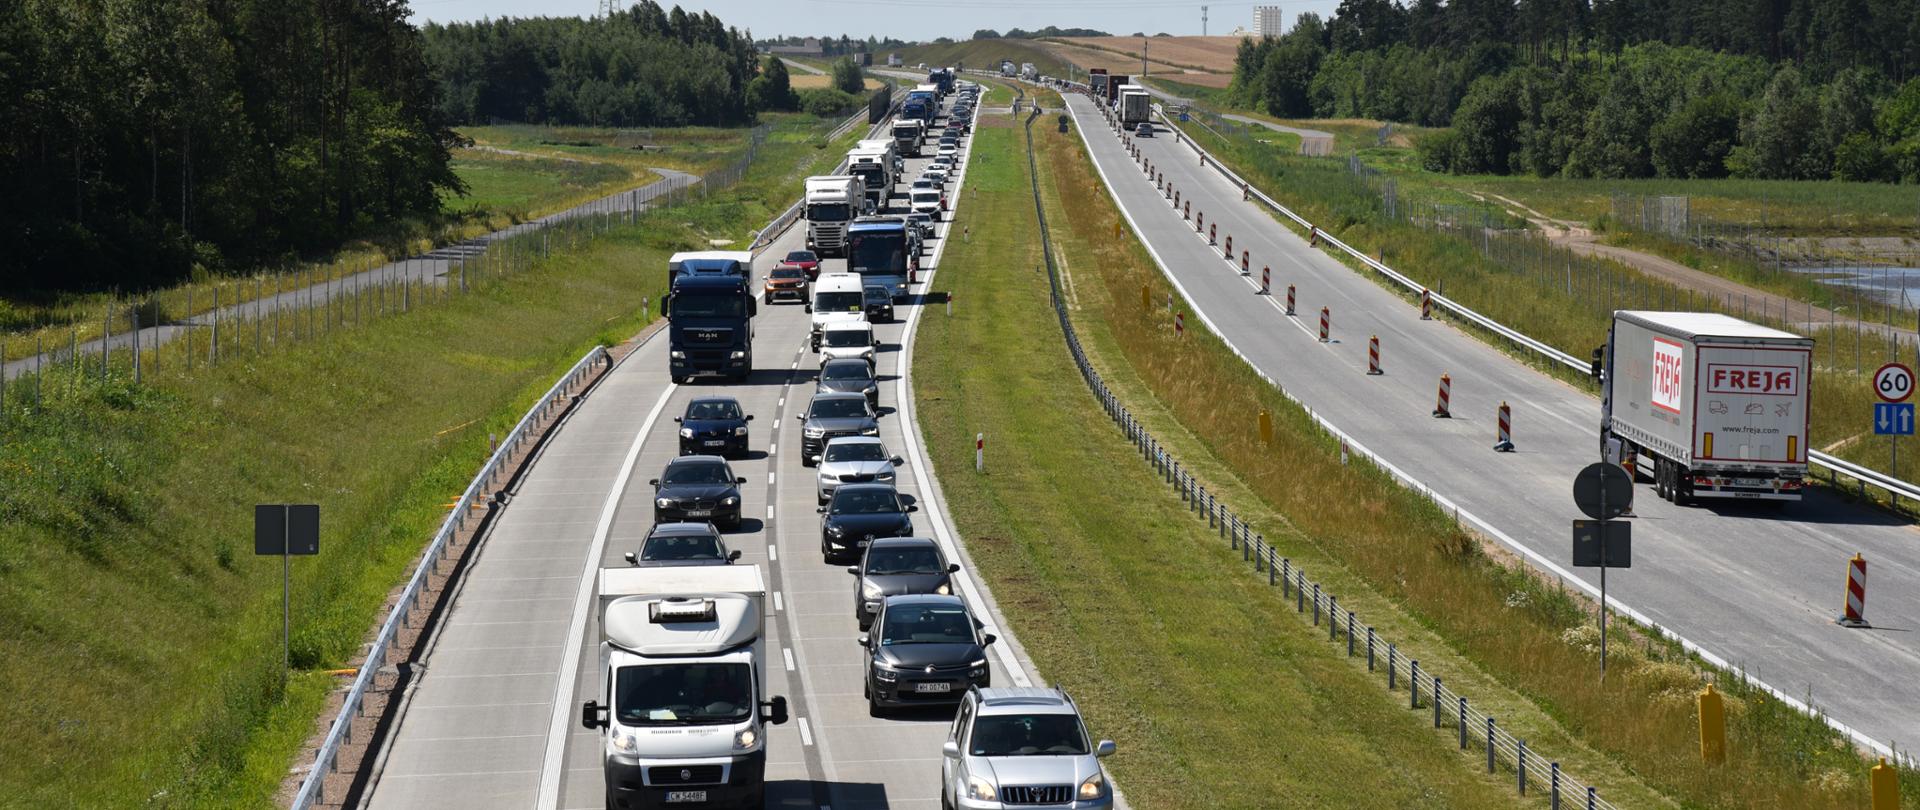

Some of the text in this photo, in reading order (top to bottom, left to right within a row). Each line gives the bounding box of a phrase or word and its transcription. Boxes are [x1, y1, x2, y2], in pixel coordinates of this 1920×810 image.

[1654, 351, 1680, 403] FREJA
[1714, 369, 1792, 392] FREJA
[1880, 372, 1908, 392] 60
[1722, 425, 1780, 435] www.freja.com
